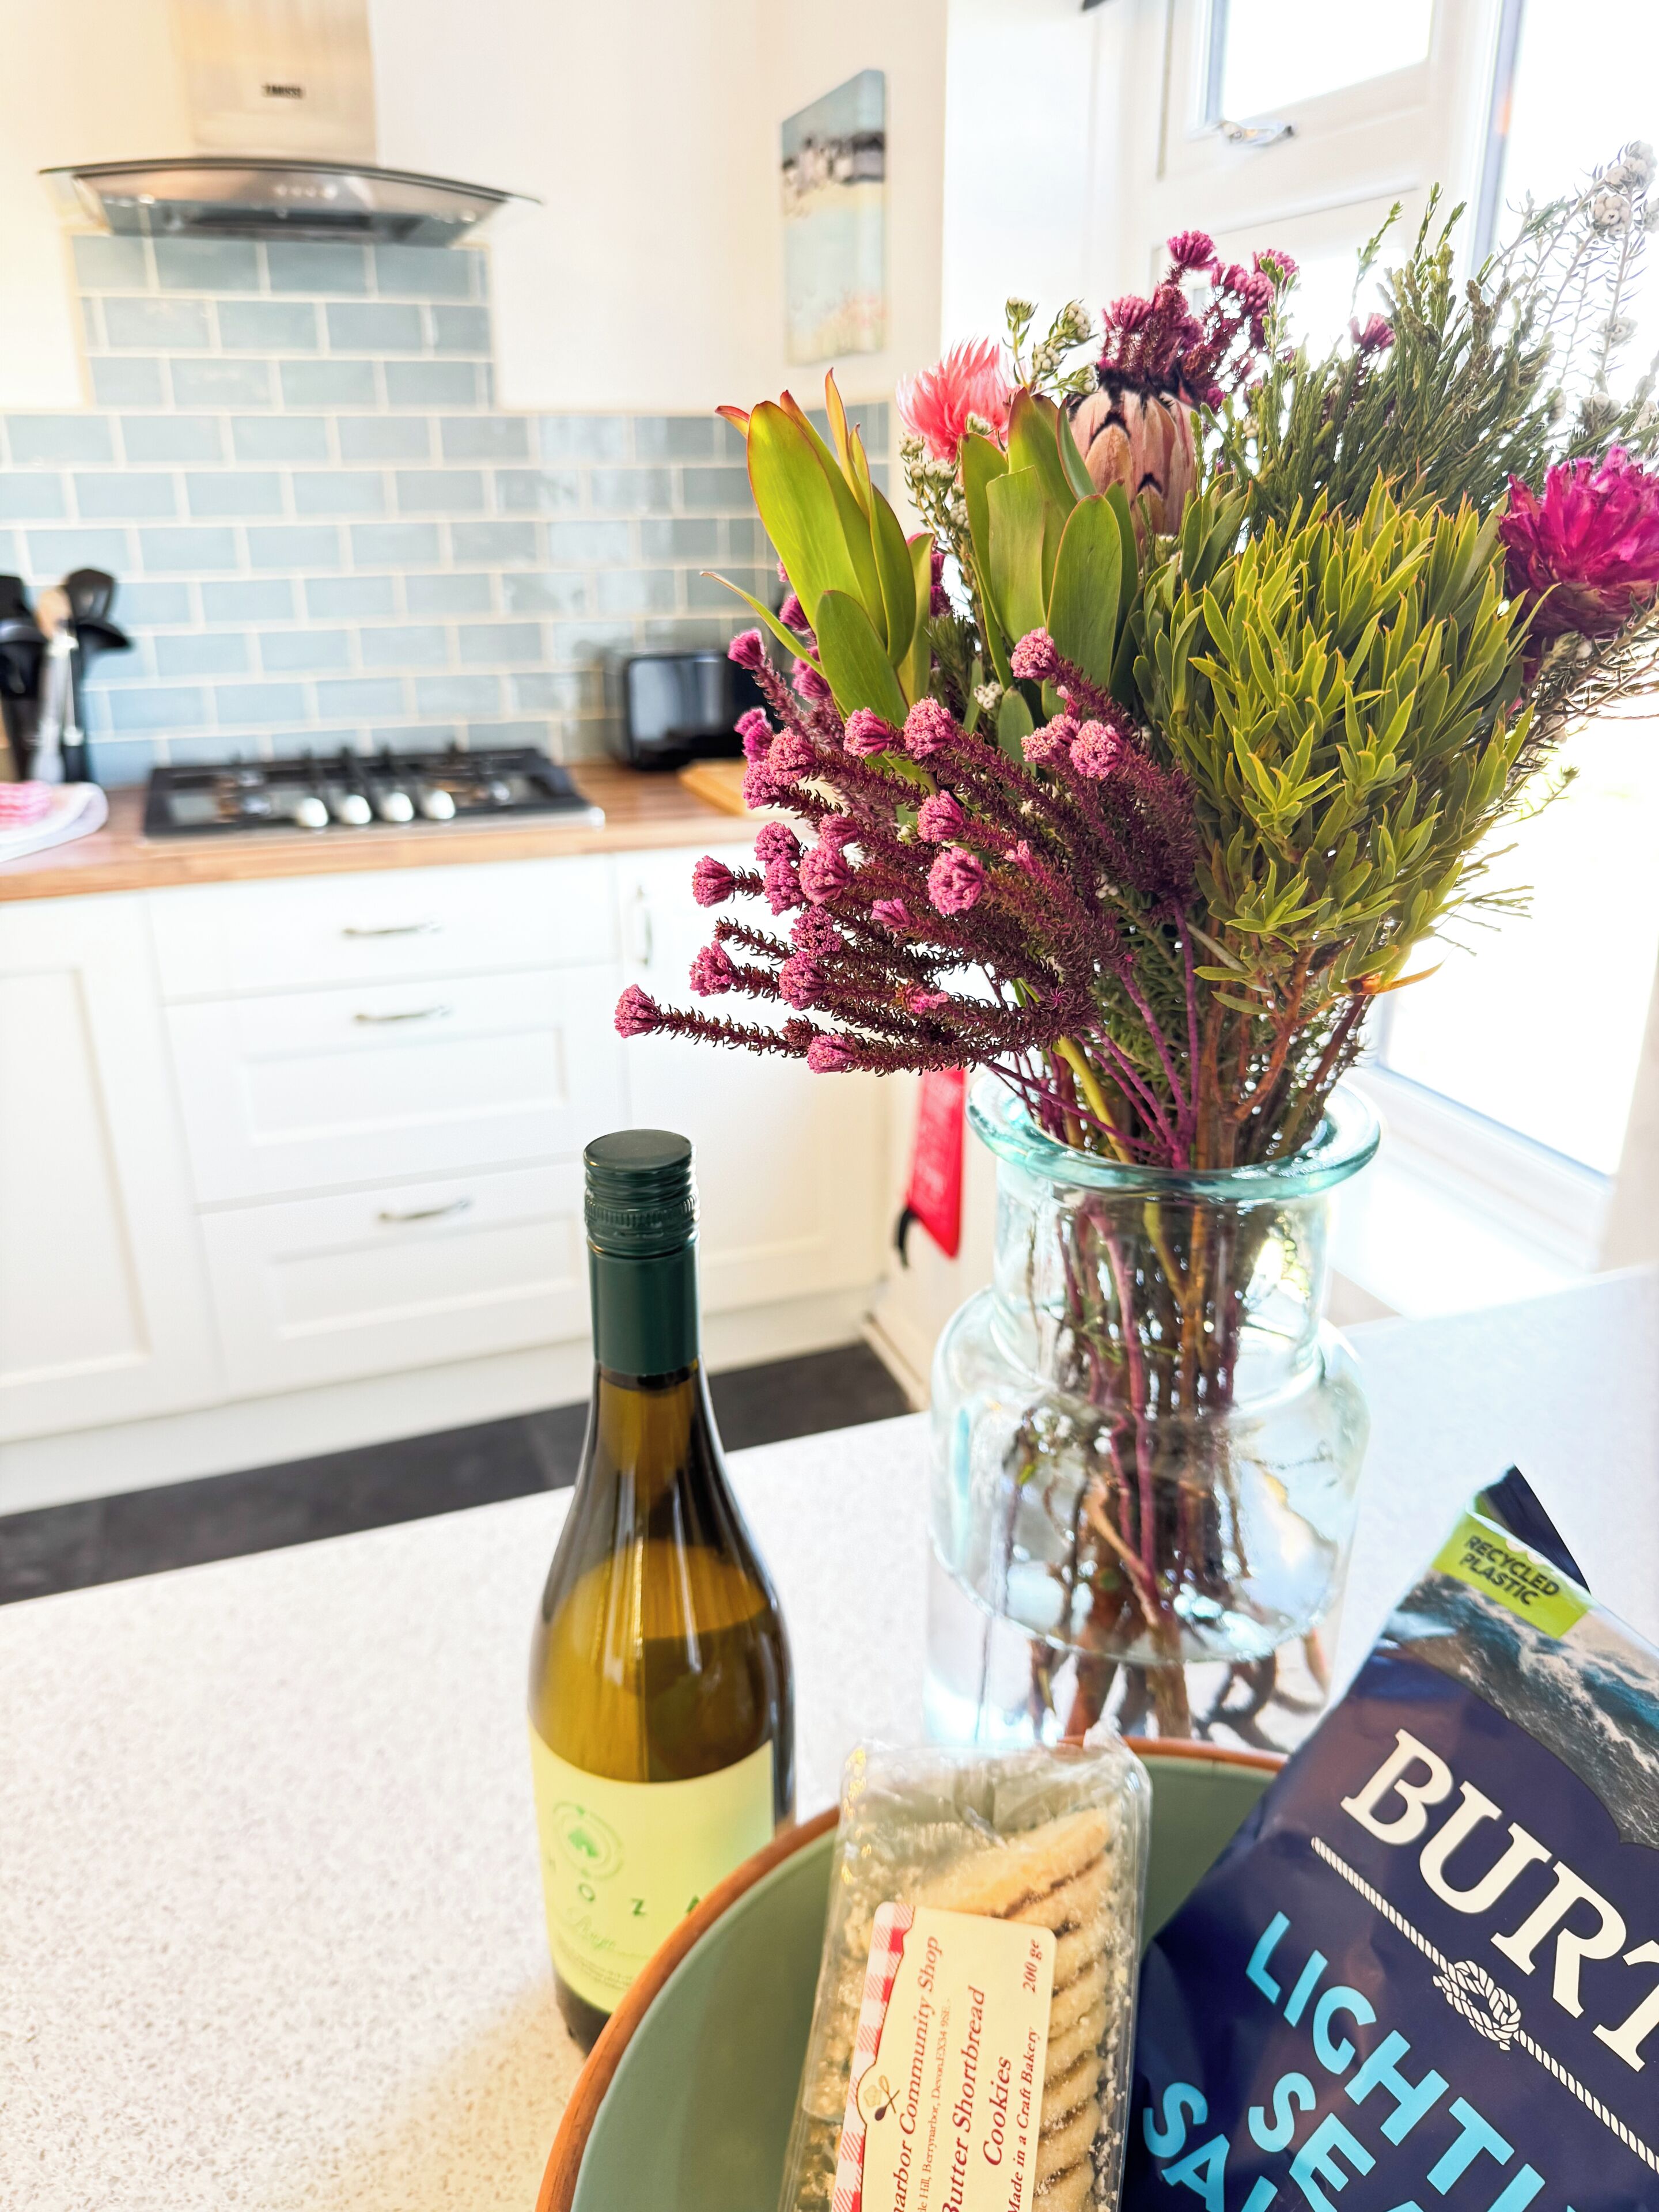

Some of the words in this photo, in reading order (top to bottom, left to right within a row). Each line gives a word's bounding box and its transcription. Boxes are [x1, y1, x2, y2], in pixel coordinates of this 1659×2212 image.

[1459, 1554, 1539, 1605] PLASTIC
[1464, 1535, 1560, 1596] RECYCLED
[917, 1936, 943, 1993] Shop
[1022, 1961, 1038, 1994] 200
[899, 1997, 936, 2135] Community
[952, 1985, 984, 2133] Shortbread
[1021, 2026, 1040, 2085] Bakery
[1245, 1911, 1577, 2212] LIGHT
[921, 2103, 941, 2173] Berrynarbor,
[983, 2056, 1012, 2166] Cookies
[1016, 2088, 1031, 2129] Craft
[1013, 2150, 1025, 2168] in
[1018, 2135, 1027, 2146] a
[1248, 2072, 1425, 2212] SE
[1008, 2171, 1024, 2212] Made
